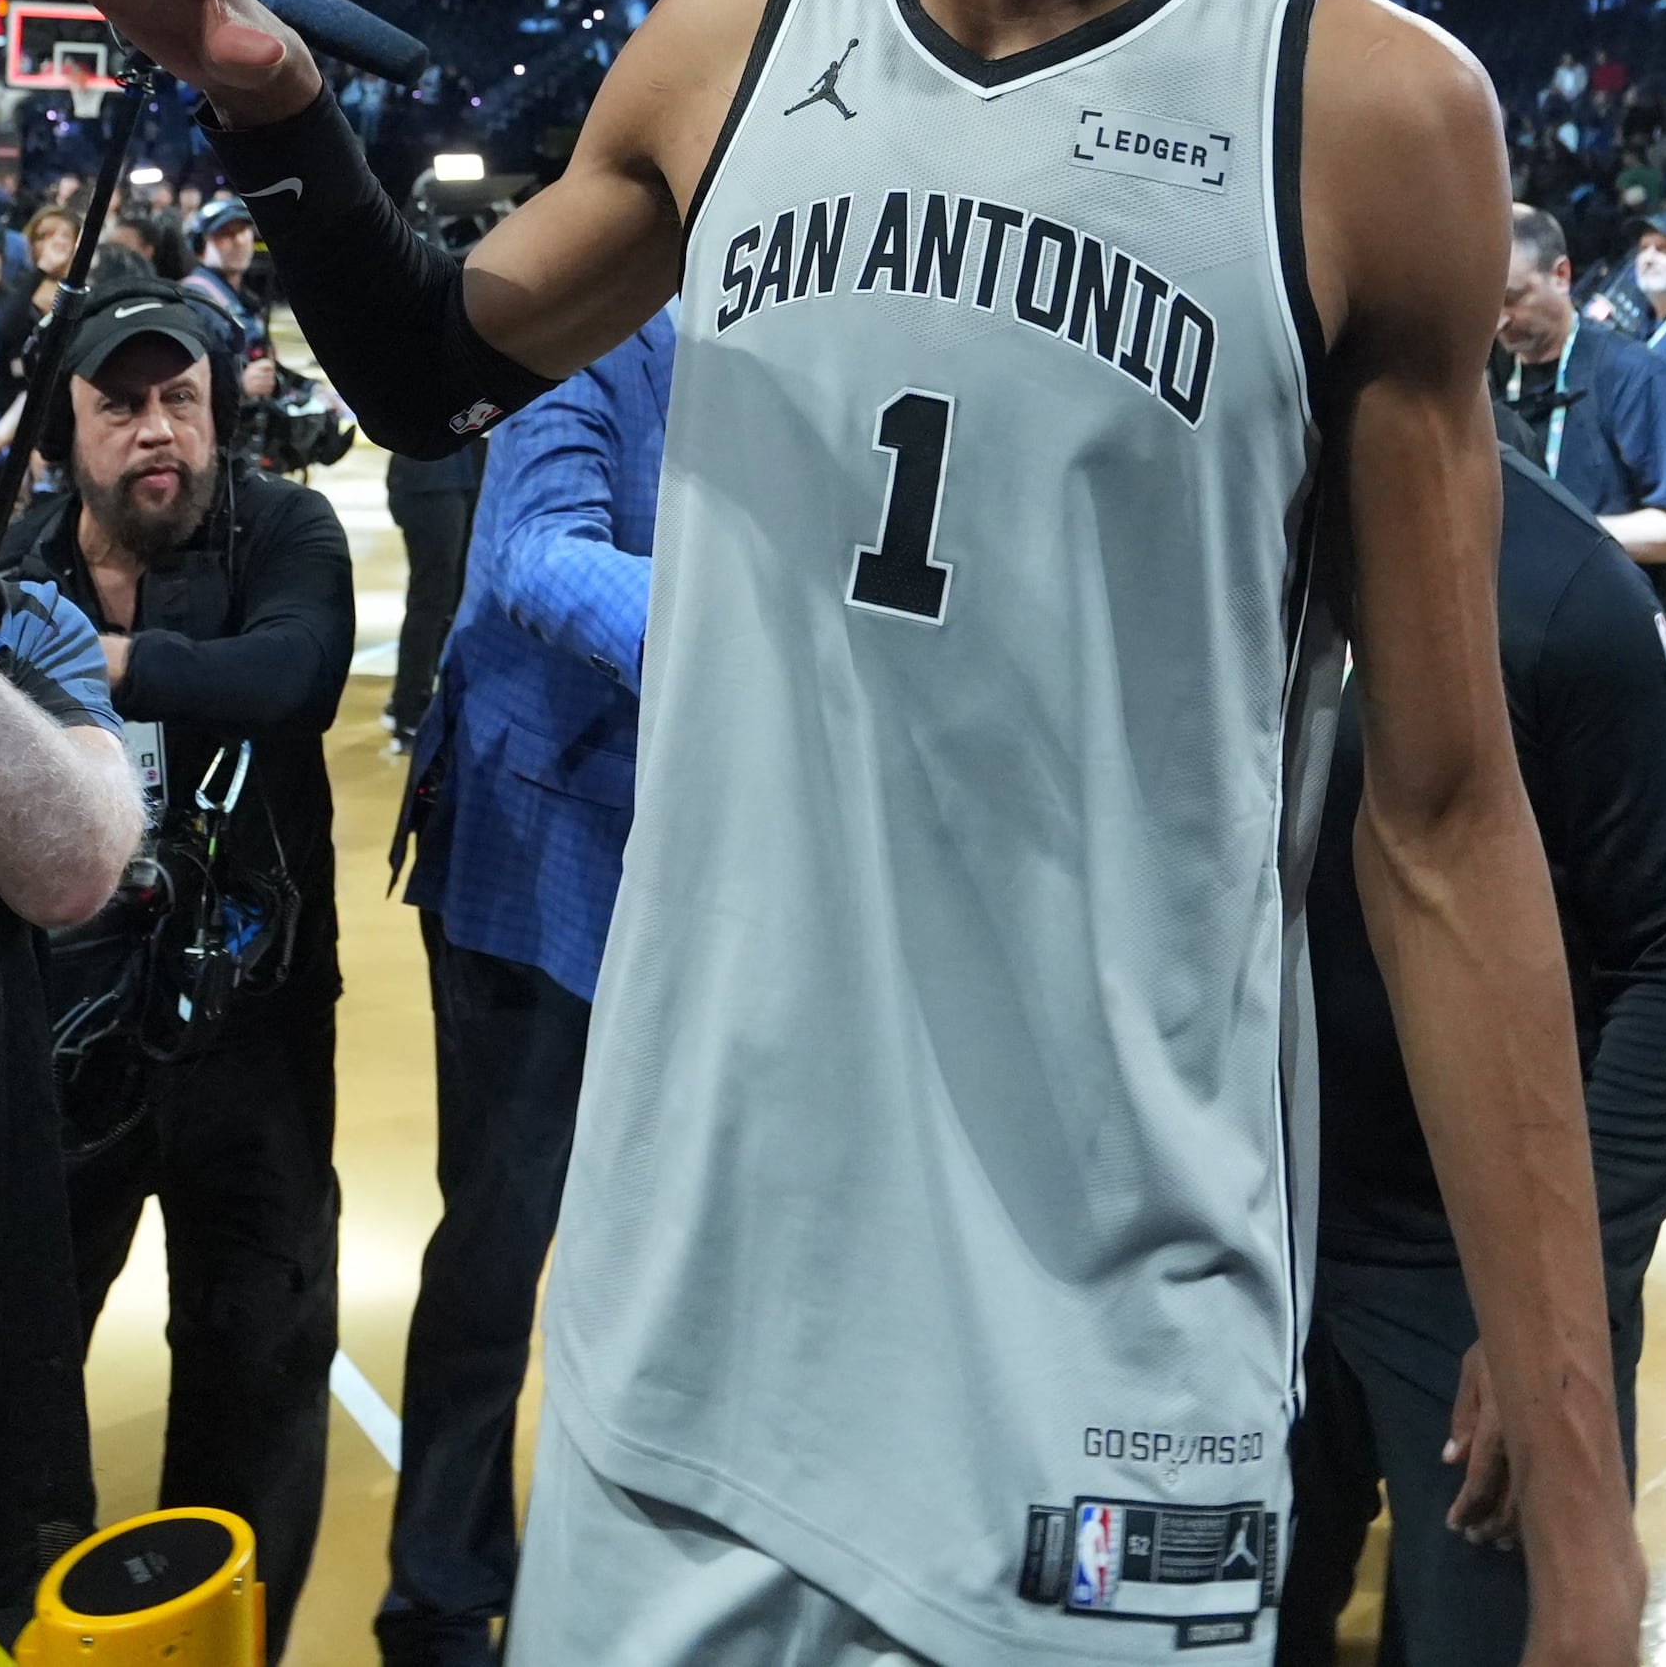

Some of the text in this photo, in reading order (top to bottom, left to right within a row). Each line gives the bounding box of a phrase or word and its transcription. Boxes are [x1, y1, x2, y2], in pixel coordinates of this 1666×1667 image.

[1095, 126, 1208, 168] LEDGER
[717, 189, 1219, 431] SAN ANTONIO
[844, 386, 956, 627] 1
[1085, 1427, 1124, 1459] GO
